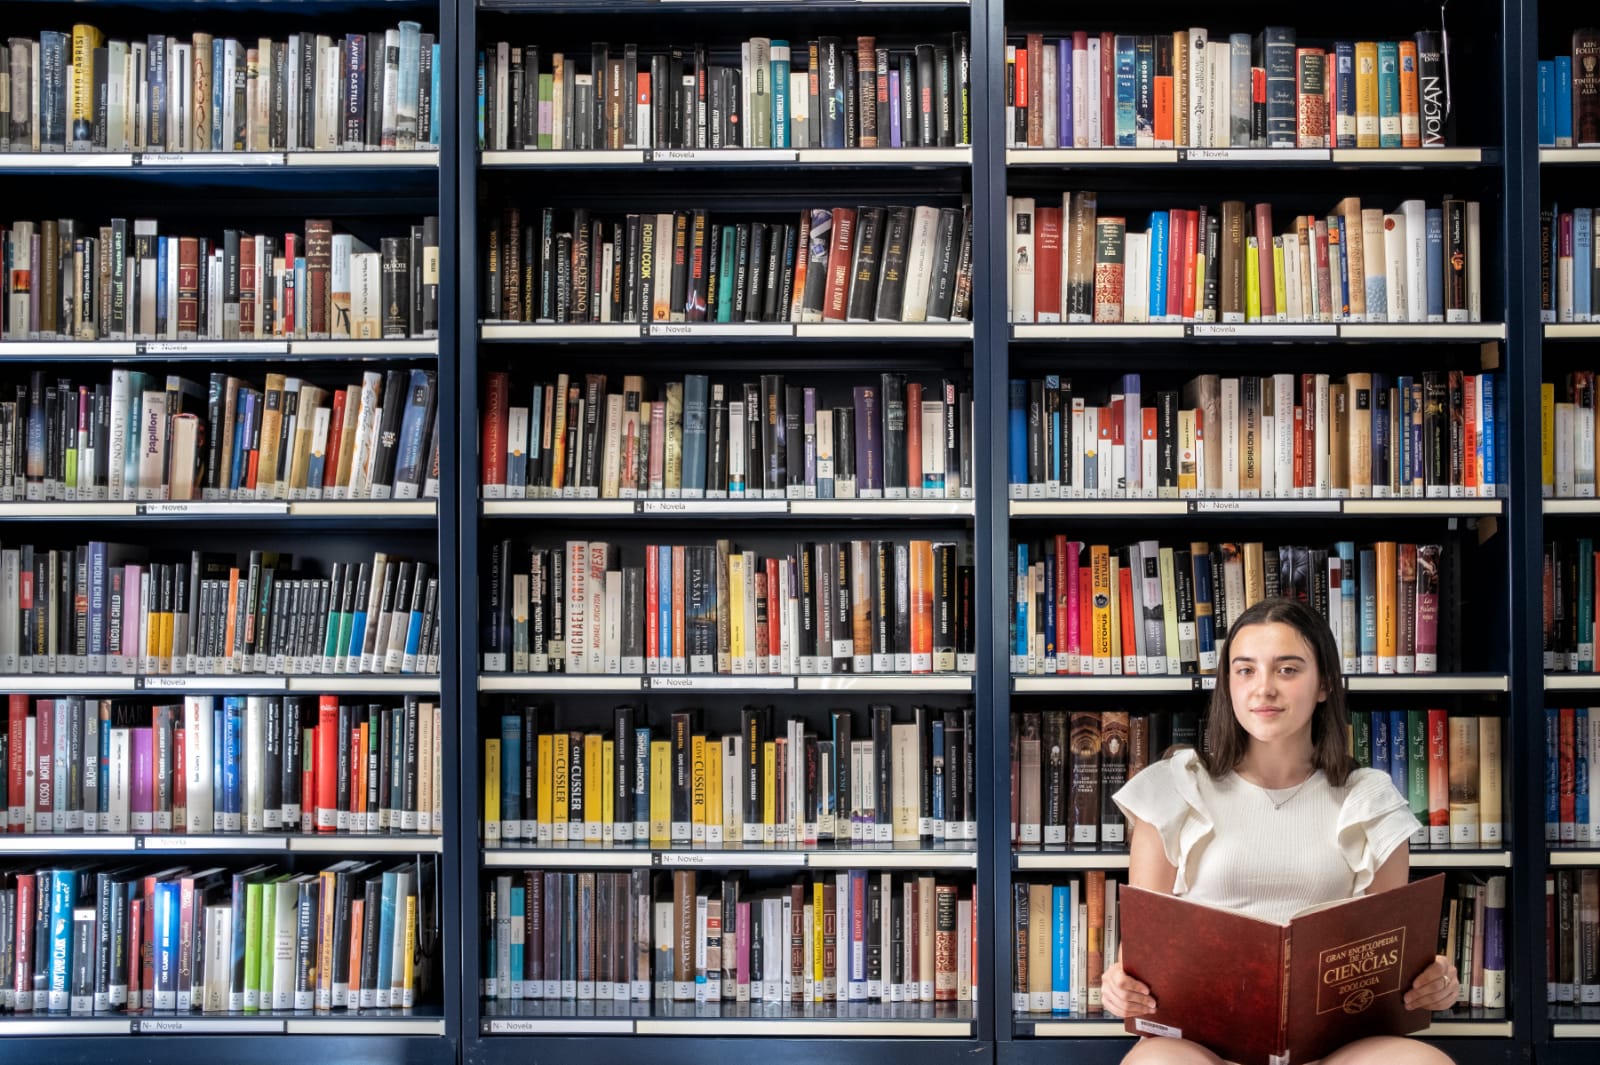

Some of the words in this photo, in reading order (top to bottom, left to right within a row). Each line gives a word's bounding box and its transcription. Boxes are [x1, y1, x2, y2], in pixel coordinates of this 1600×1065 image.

[76, 36, 84, 74] CARRISI
[350, 41, 358, 71] JAVIER
[76, 77, 84, 114] DONATO
[350, 73, 358, 113] CASTILLO
[777, 95, 785, 122] CONNELLY
[828, 97, 836, 120] ADN
[544, 237, 552, 260] Cook
[643, 224, 652, 252] ROBIN
[642, 253, 652, 278] COOK
[114, 280, 124, 308] Ritual
[578, 267, 588, 312] DESTINO
[114, 309, 124, 320] El
[94, 554, 102, 582] LINCOLN
[531, 554, 542, 574] PARK
[571, 546, 584, 602] CRICHTON
[591, 548, 604, 580] PRESA
[93, 583, 102, 608] CHILD
[692, 569, 702, 609] PASAJE
[702, 584, 709, 594] EL
[112, 595, 121, 618] CHILD
[92, 613, 100, 652] TORMENTA
[110, 620, 120, 651] LINCOLN
[407, 702, 416, 718] MARY
[407, 719, 416, 744] HIGGINS
[406, 745, 415, 763] CLARK
[636, 732, 646, 758] TITANIC
[39, 755, 50, 780] MORTAL
[556, 758, 566, 802] CUSSLER
[571, 766, 582, 810] CUSSLER
[695, 760, 705, 805] CUSSLER
[839, 770, 847, 792] INCA
[300, 902, 310, 928] VERDAD
[102, 922, 110, 942] CLARK
[53, 938, 66, 958] CLARK
[299, 938, 308, 953] TODA
[1326, 951, 1347, 964] GRAN
[1348, 935, 1398, 956] ENCICLOPEDIA
[1349, 953, 1360, 963] DE
[1361, 950, 1375, 960] LAS
[1323, 949, 1399, 985] CIENCIAS
